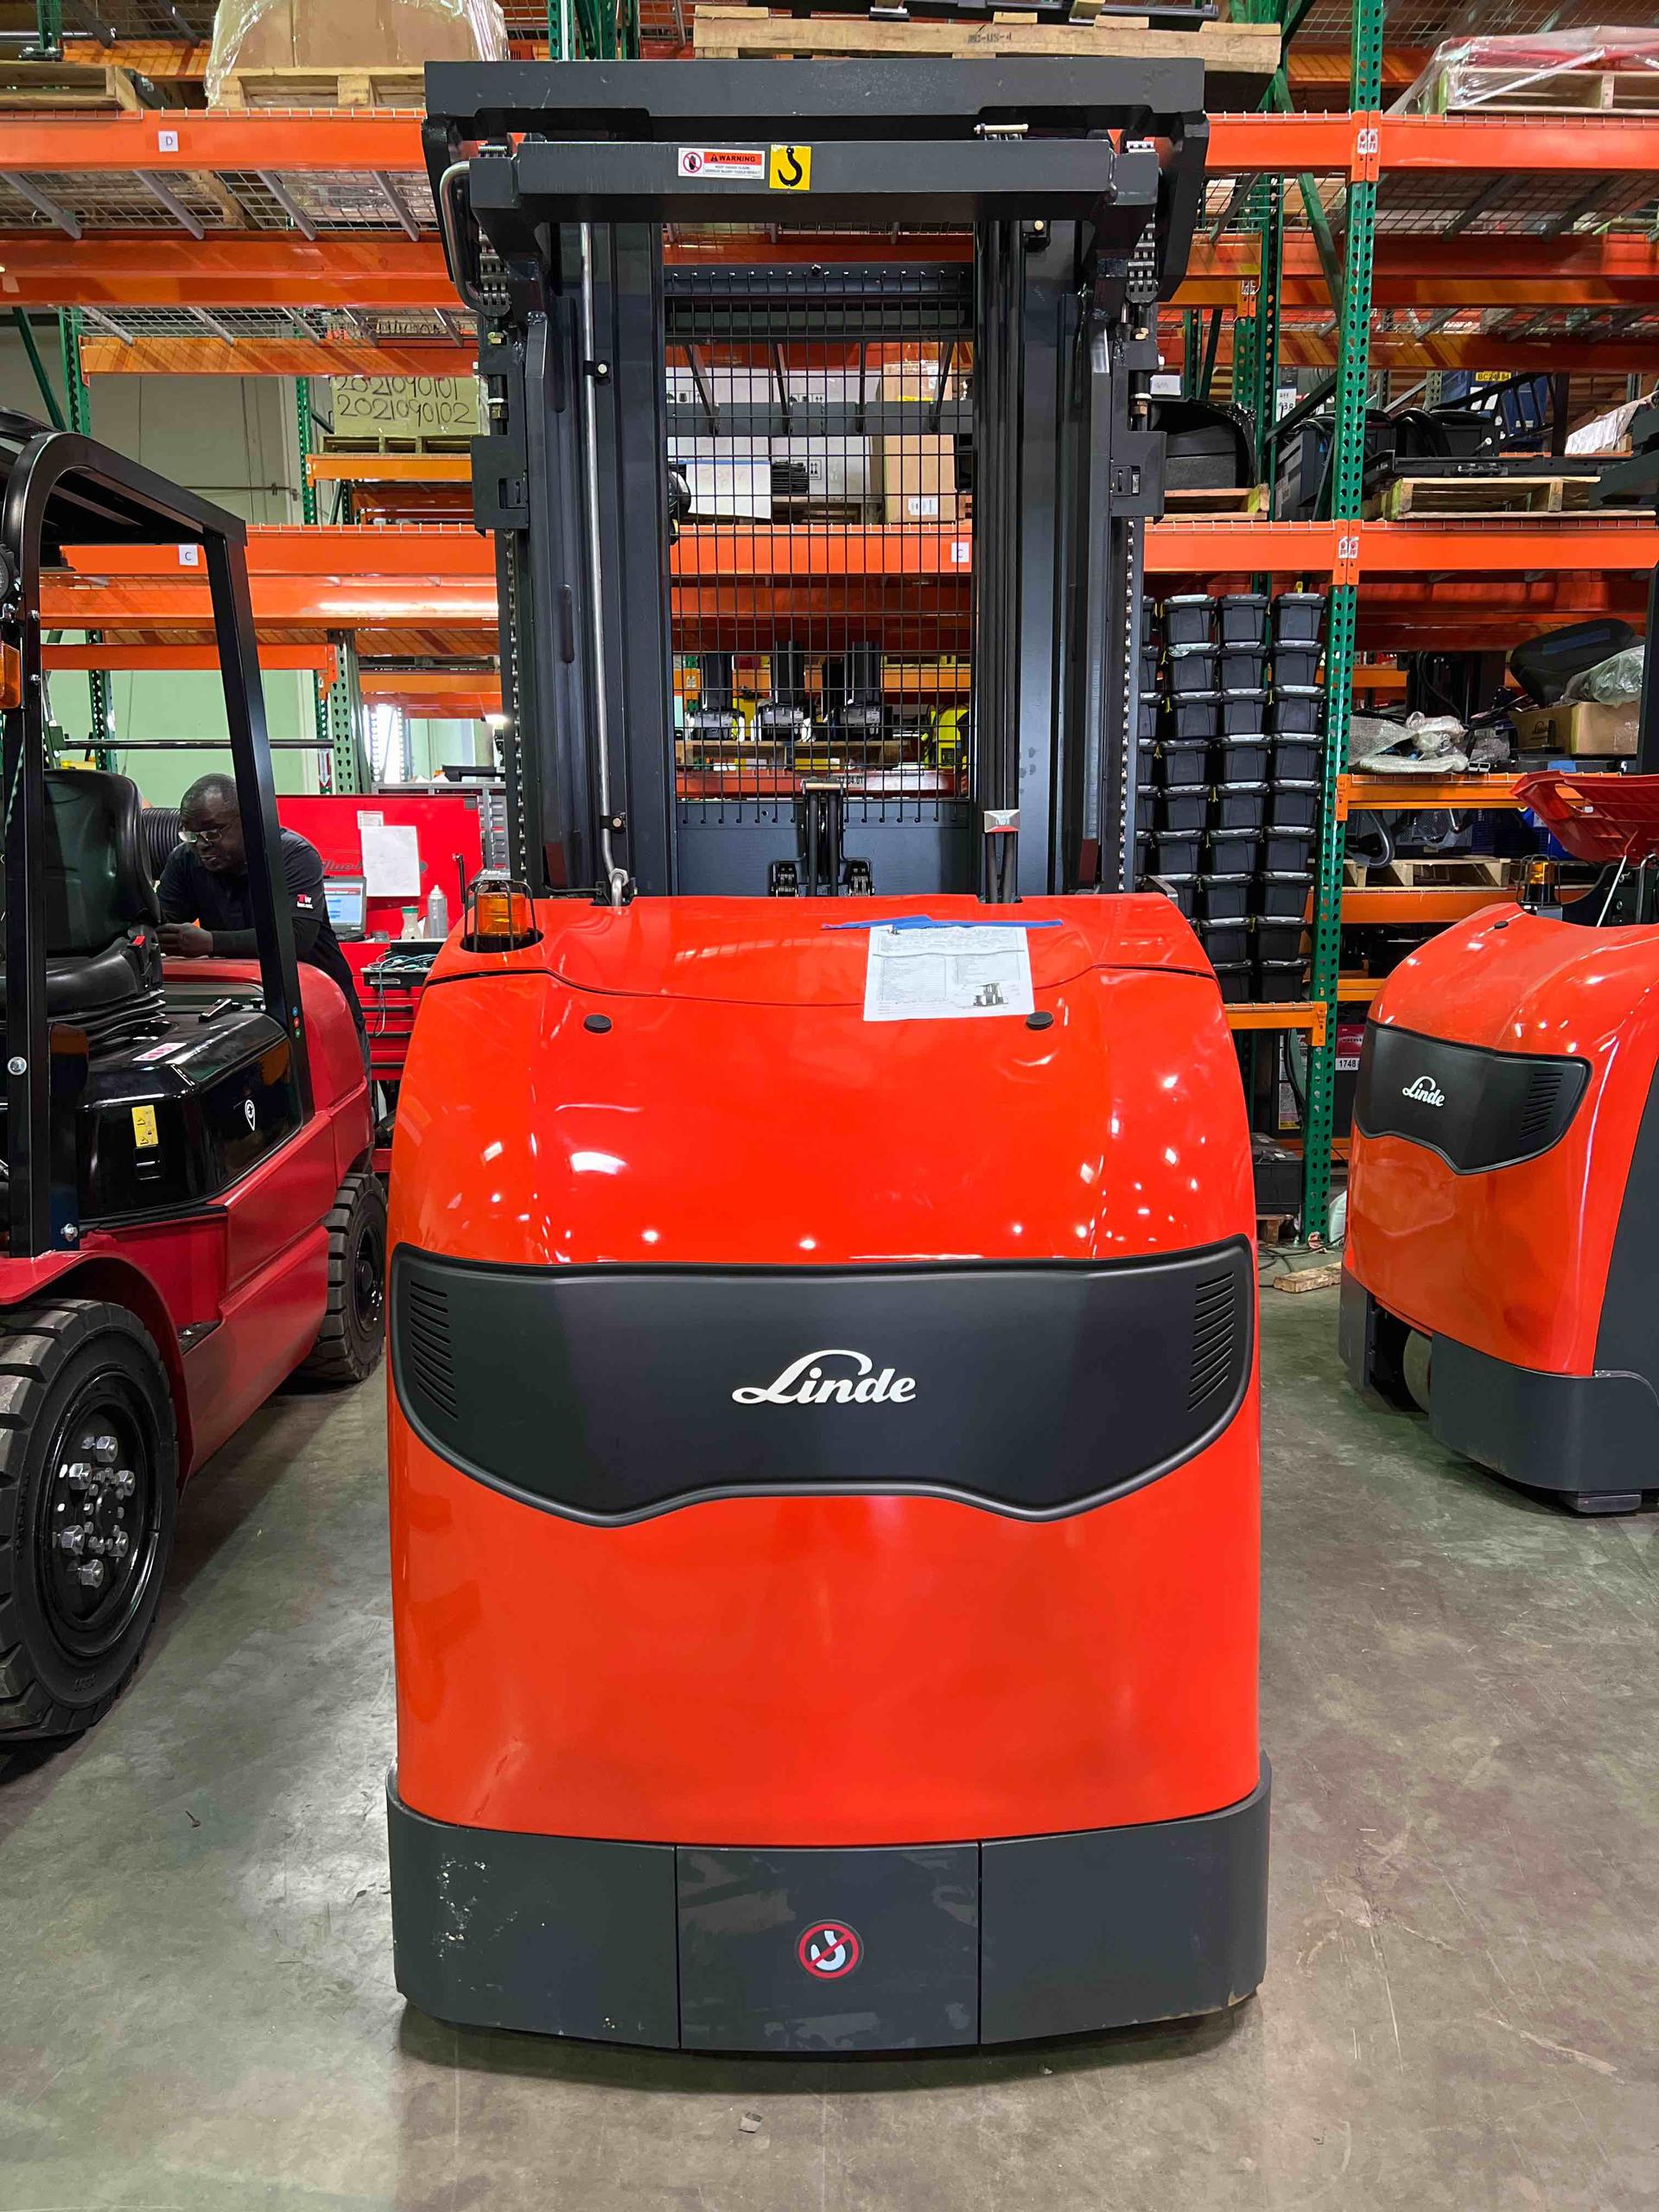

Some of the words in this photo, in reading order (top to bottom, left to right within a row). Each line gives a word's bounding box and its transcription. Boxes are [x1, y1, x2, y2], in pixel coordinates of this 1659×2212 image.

[165, 136, 173, 146] D
[337, 394, 477, 428] 2021090102
[184, 551, 192, 562] C
[1338, 1059, 1357, 1068] 1748
[1402, 1076, 1446, 1107] Linde
[732, 1349, 917, 1404] Linde
